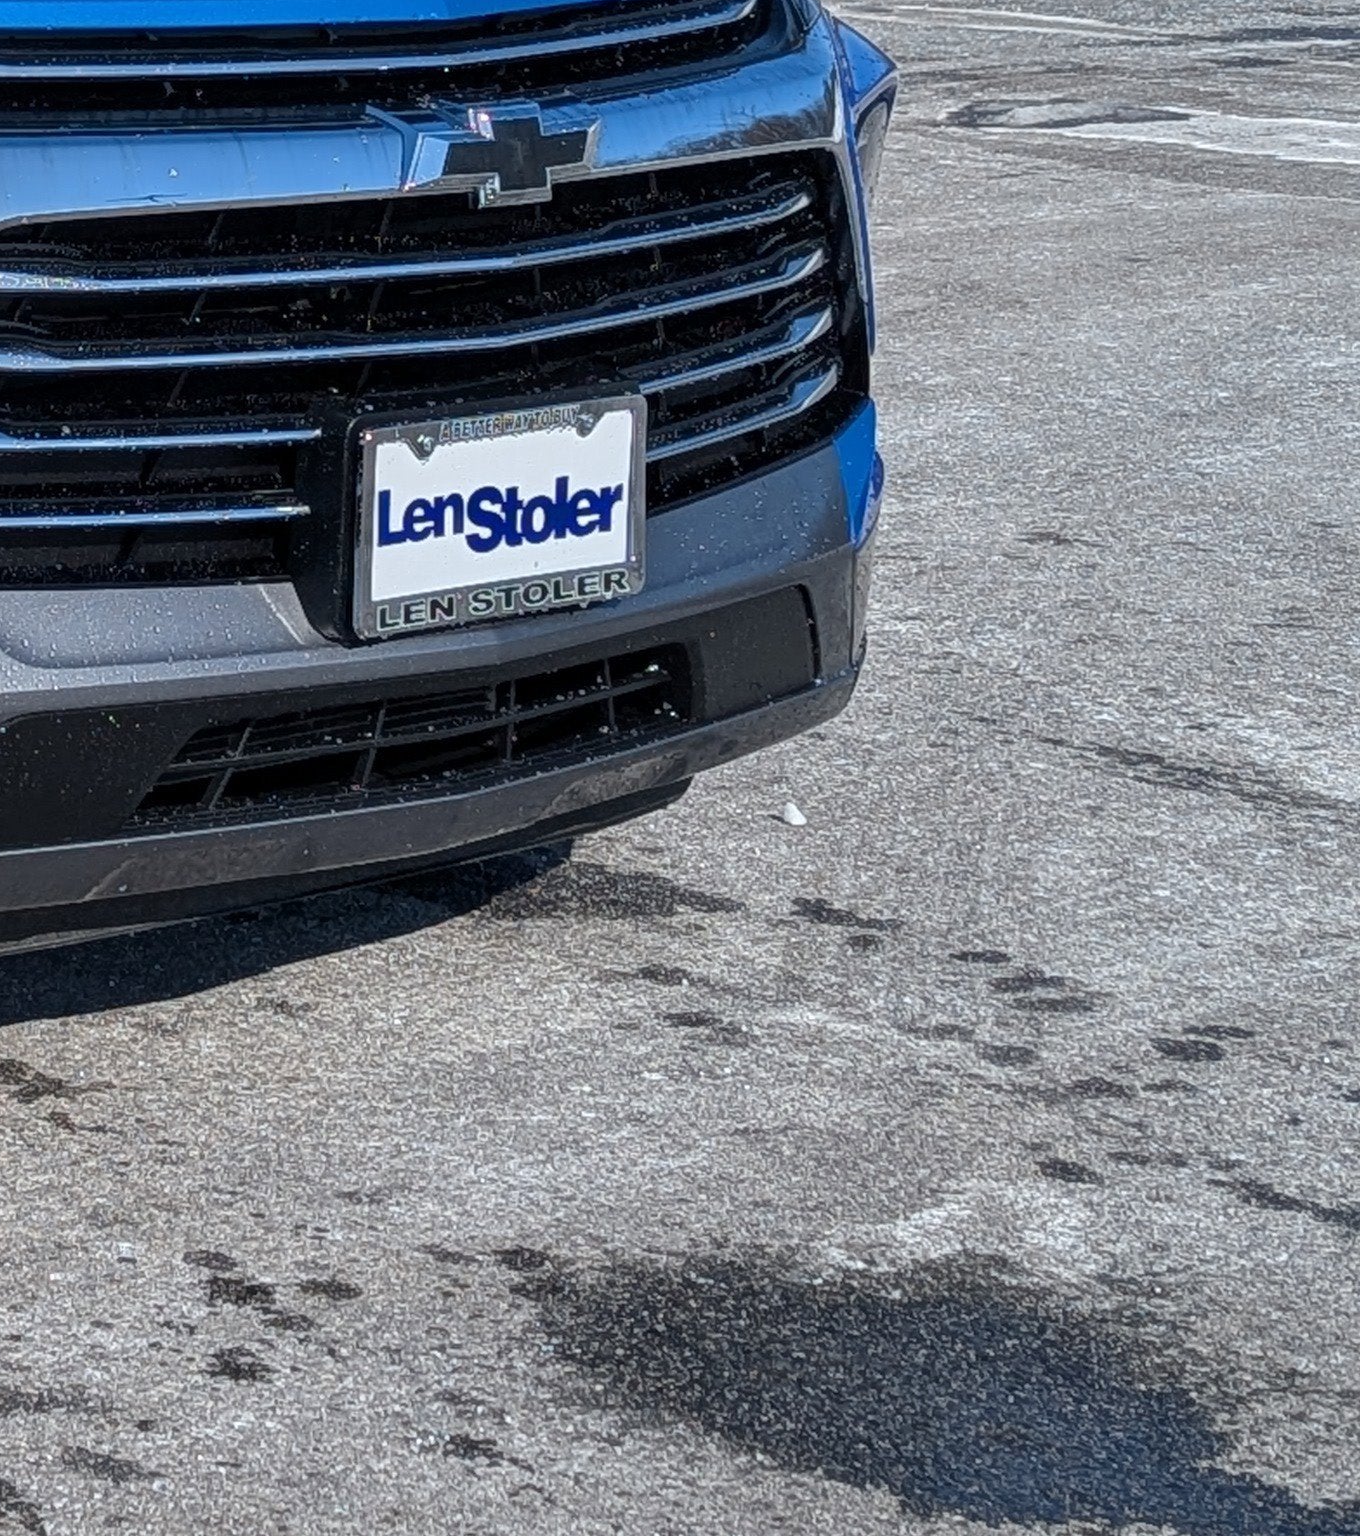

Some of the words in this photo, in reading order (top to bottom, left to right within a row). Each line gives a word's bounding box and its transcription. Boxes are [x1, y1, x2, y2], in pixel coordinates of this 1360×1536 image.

[439, 422, 451, 442] A
[451, 416, 502, 440] BETTER
[377, 596, 456, 631] LEN
[469, 570, 629, 615] STOLER
